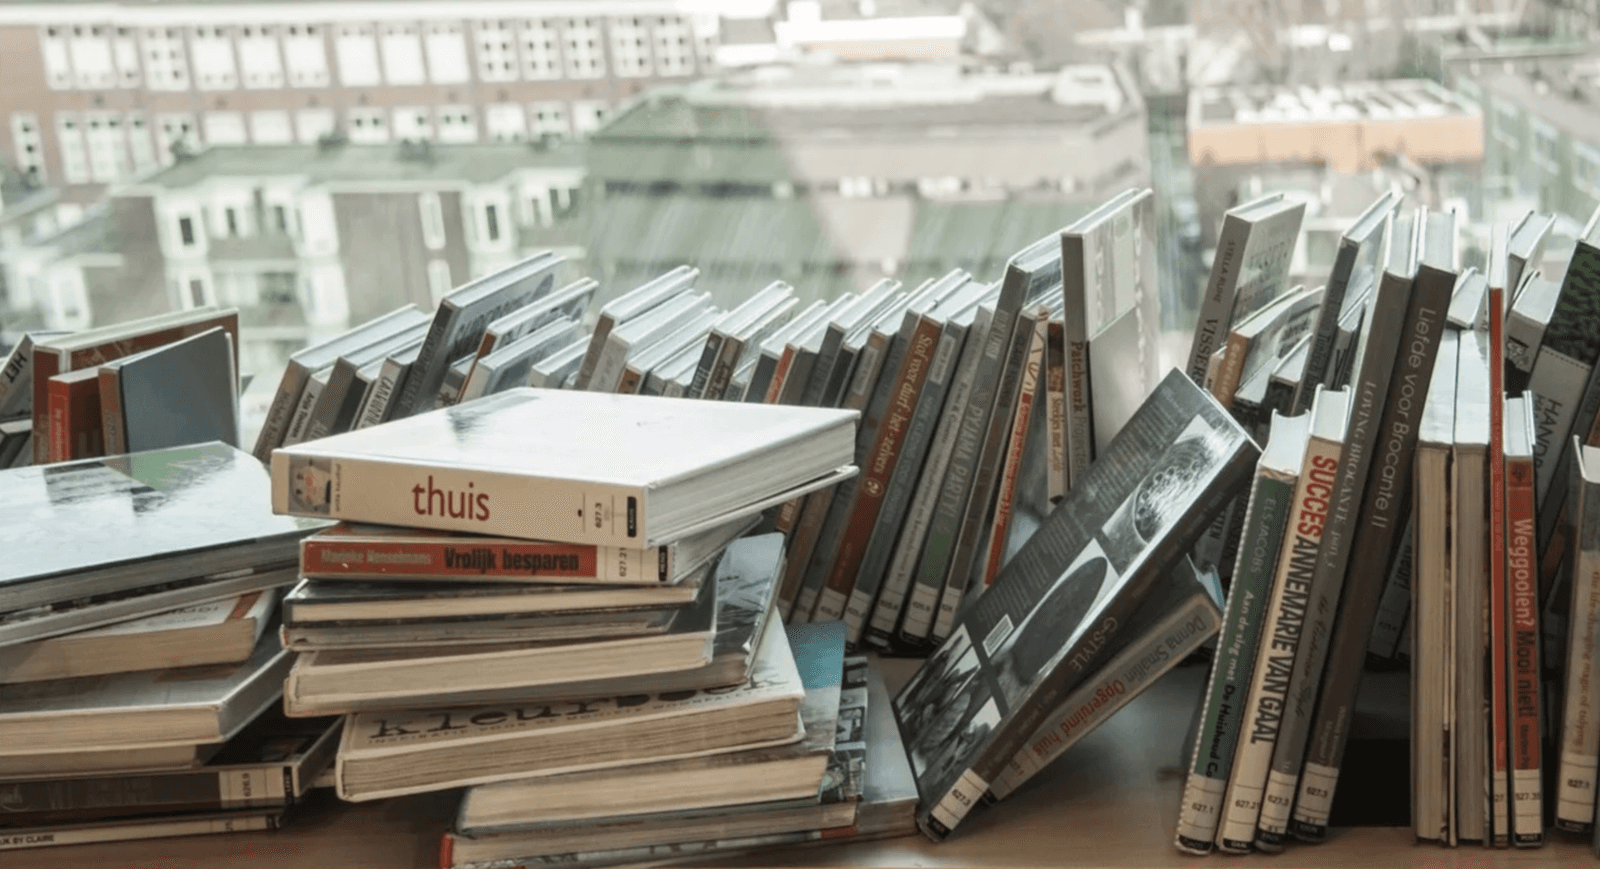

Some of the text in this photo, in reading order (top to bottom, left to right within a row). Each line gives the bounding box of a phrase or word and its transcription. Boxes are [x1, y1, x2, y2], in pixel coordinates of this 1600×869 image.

[1218, 239, 1237, 274] STELLA
[913, 334, 935, 359] Stof
[1406, 307, 1436, 369] Liefde
[1, 350, 28, 382] HET
[905, 355, 925, 381] voor
[1070, 341, 1086, 411] Patchwork
[1394, 372, 1419, 418] voor
[1353, 380, 1377, 447] LOVING
[958, 404, 985, 460] PYJAMA
[1372, 421, 1411, 512] Brocante
[412, 475, 490, 521] thuis
[1333, 447, 1361, 525] BROCANTE
[594, 502, 602, 528] 627.3
[1370, 514, 1388, 529] II
[1248, 497, 1274, 573] ELS JACOBS
[444, 547, 579, 575] Vrolijk besparen
[1508, 518, 1535, 626] Weggooien?
[1240, 590, 1255, 614] Aan
[1250, 455, 1338, 745] SUCCES ANNEMARIE VAN GAAL
[1170, 615, 1207, 650] Donna
[1236, 616, 1248, 632] de
[1072, 616, 1118, 671] G-STYLE
[1227, 632, 1245, 656] slag
[1516, 631, 1535, 674] Mooi
[1225, 659, 1239, 681] met
[1060, 679, 1127, 729] Opgeruimd
[1221, 684, 1235, 700] De
[1032, 730, 1060, 757] huis
[1208, 703, 1231, 759] Huishoud
[1192, 803, 1213, 814] 627.1
[1306, 786, 1328, 798] 627.3
